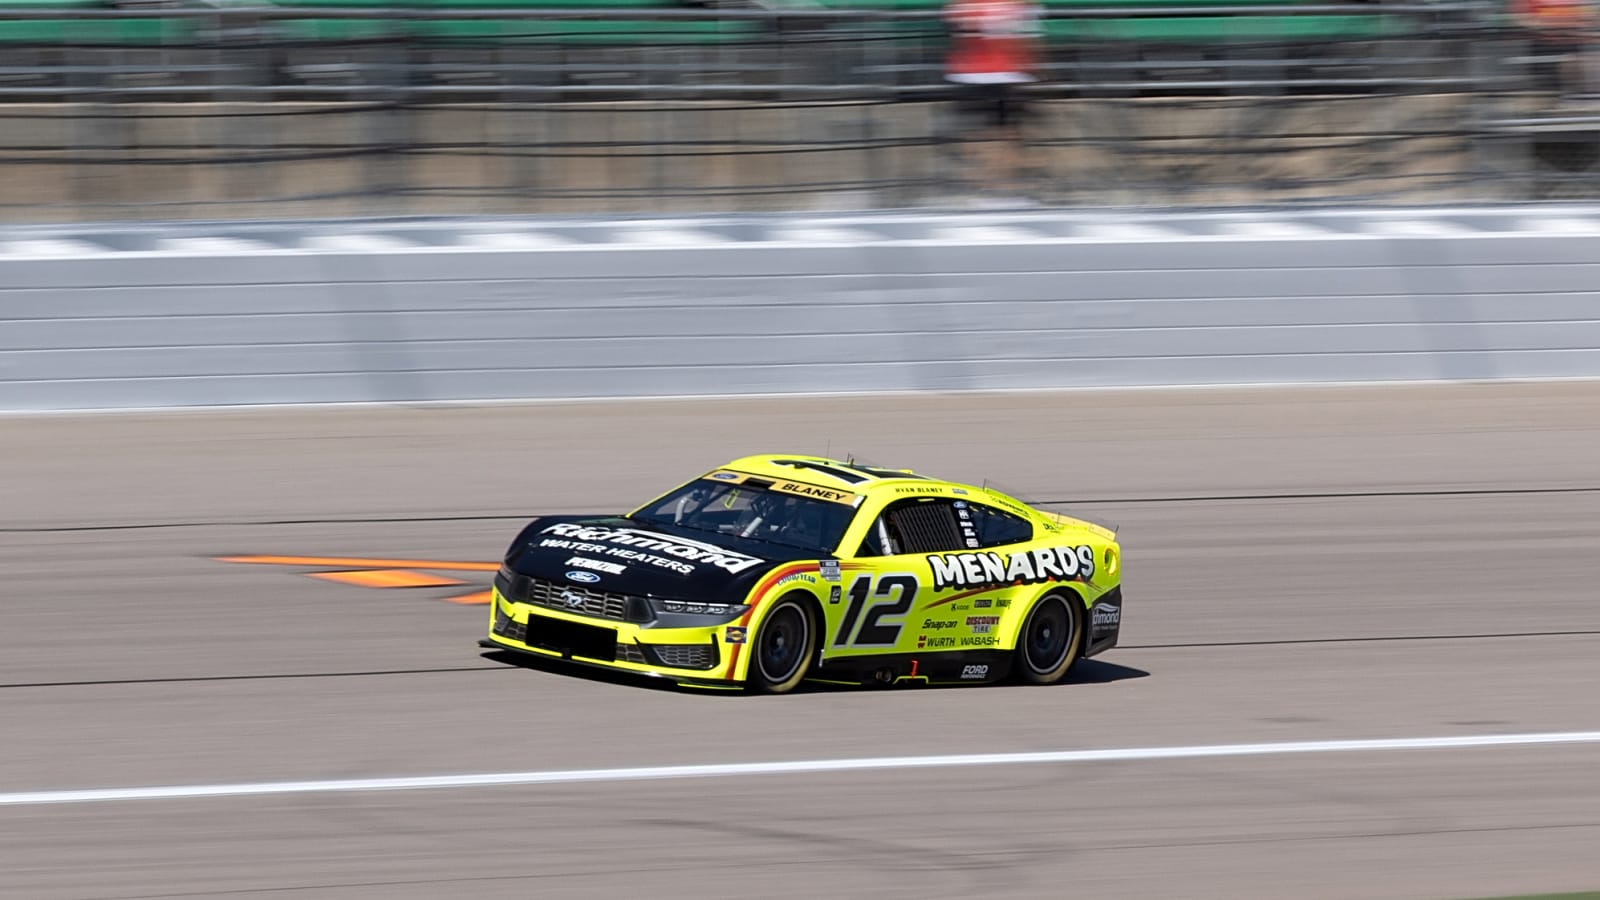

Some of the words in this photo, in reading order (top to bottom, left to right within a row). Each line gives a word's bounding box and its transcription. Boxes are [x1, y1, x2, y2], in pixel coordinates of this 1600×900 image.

[782, 483, 846, 501] BLANEY
[539, 539, 607, 553] WATER
[605, 548, 696, 574] HEATERS
[540, 523, 765, 575] Richmond
[927, 545, 1096, 591] MENARDS
[832, 574, 919, 648] 12
[922, 618, 958, 631] Snap-on
[960, 636, 1000, 646] WABASH
[962, 664, 989, 674] FORD
